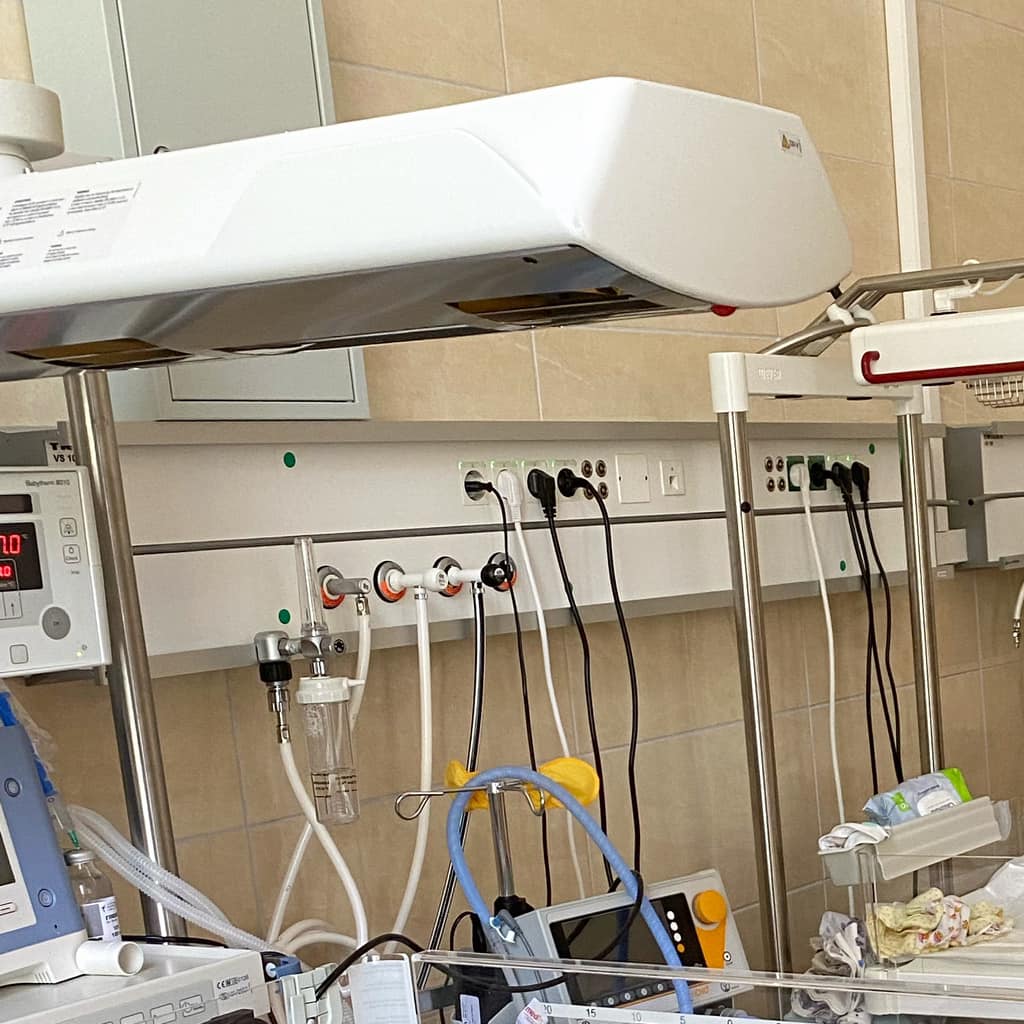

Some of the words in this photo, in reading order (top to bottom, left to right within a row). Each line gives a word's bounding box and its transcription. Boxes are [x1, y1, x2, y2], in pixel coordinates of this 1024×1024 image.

[53, 454, 65, 462] VS
[586, 1008, 597, 1018] 15
[631, 1012, 642, 1022] 10
